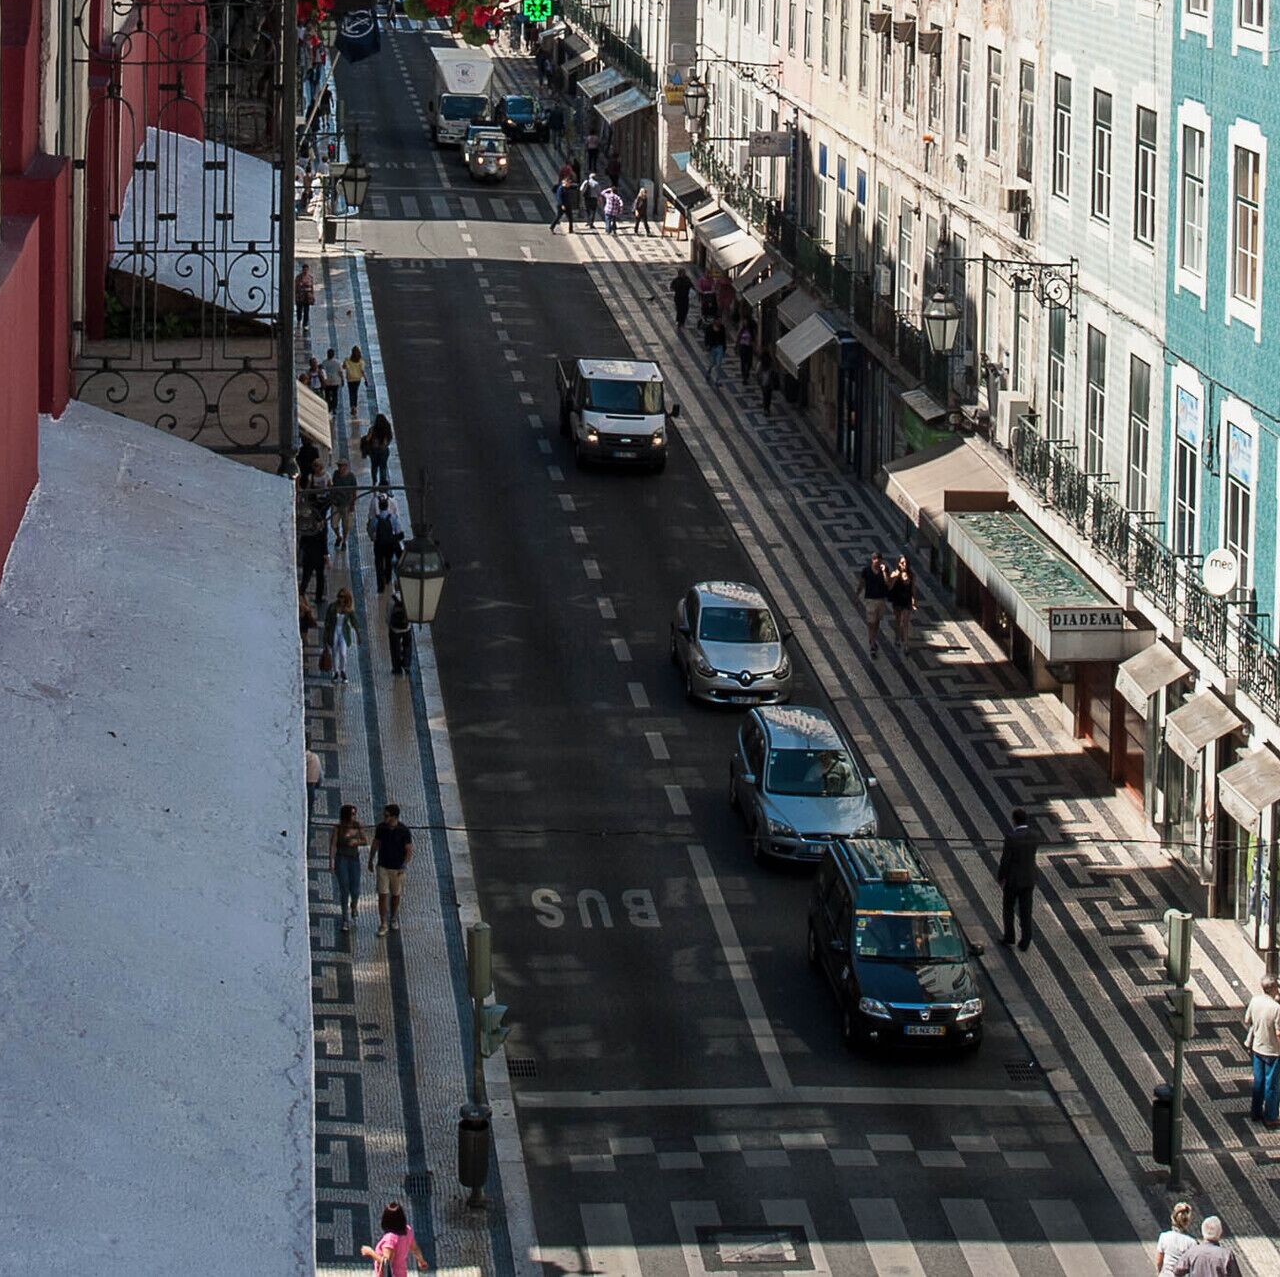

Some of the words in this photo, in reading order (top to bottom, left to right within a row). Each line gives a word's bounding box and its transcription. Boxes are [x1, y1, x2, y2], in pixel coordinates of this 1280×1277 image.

[1210, 558, 1233, 571] meo
[1053, 613, 1122, 626] DIADEMA
[531, 888, 662, 928] BUS
